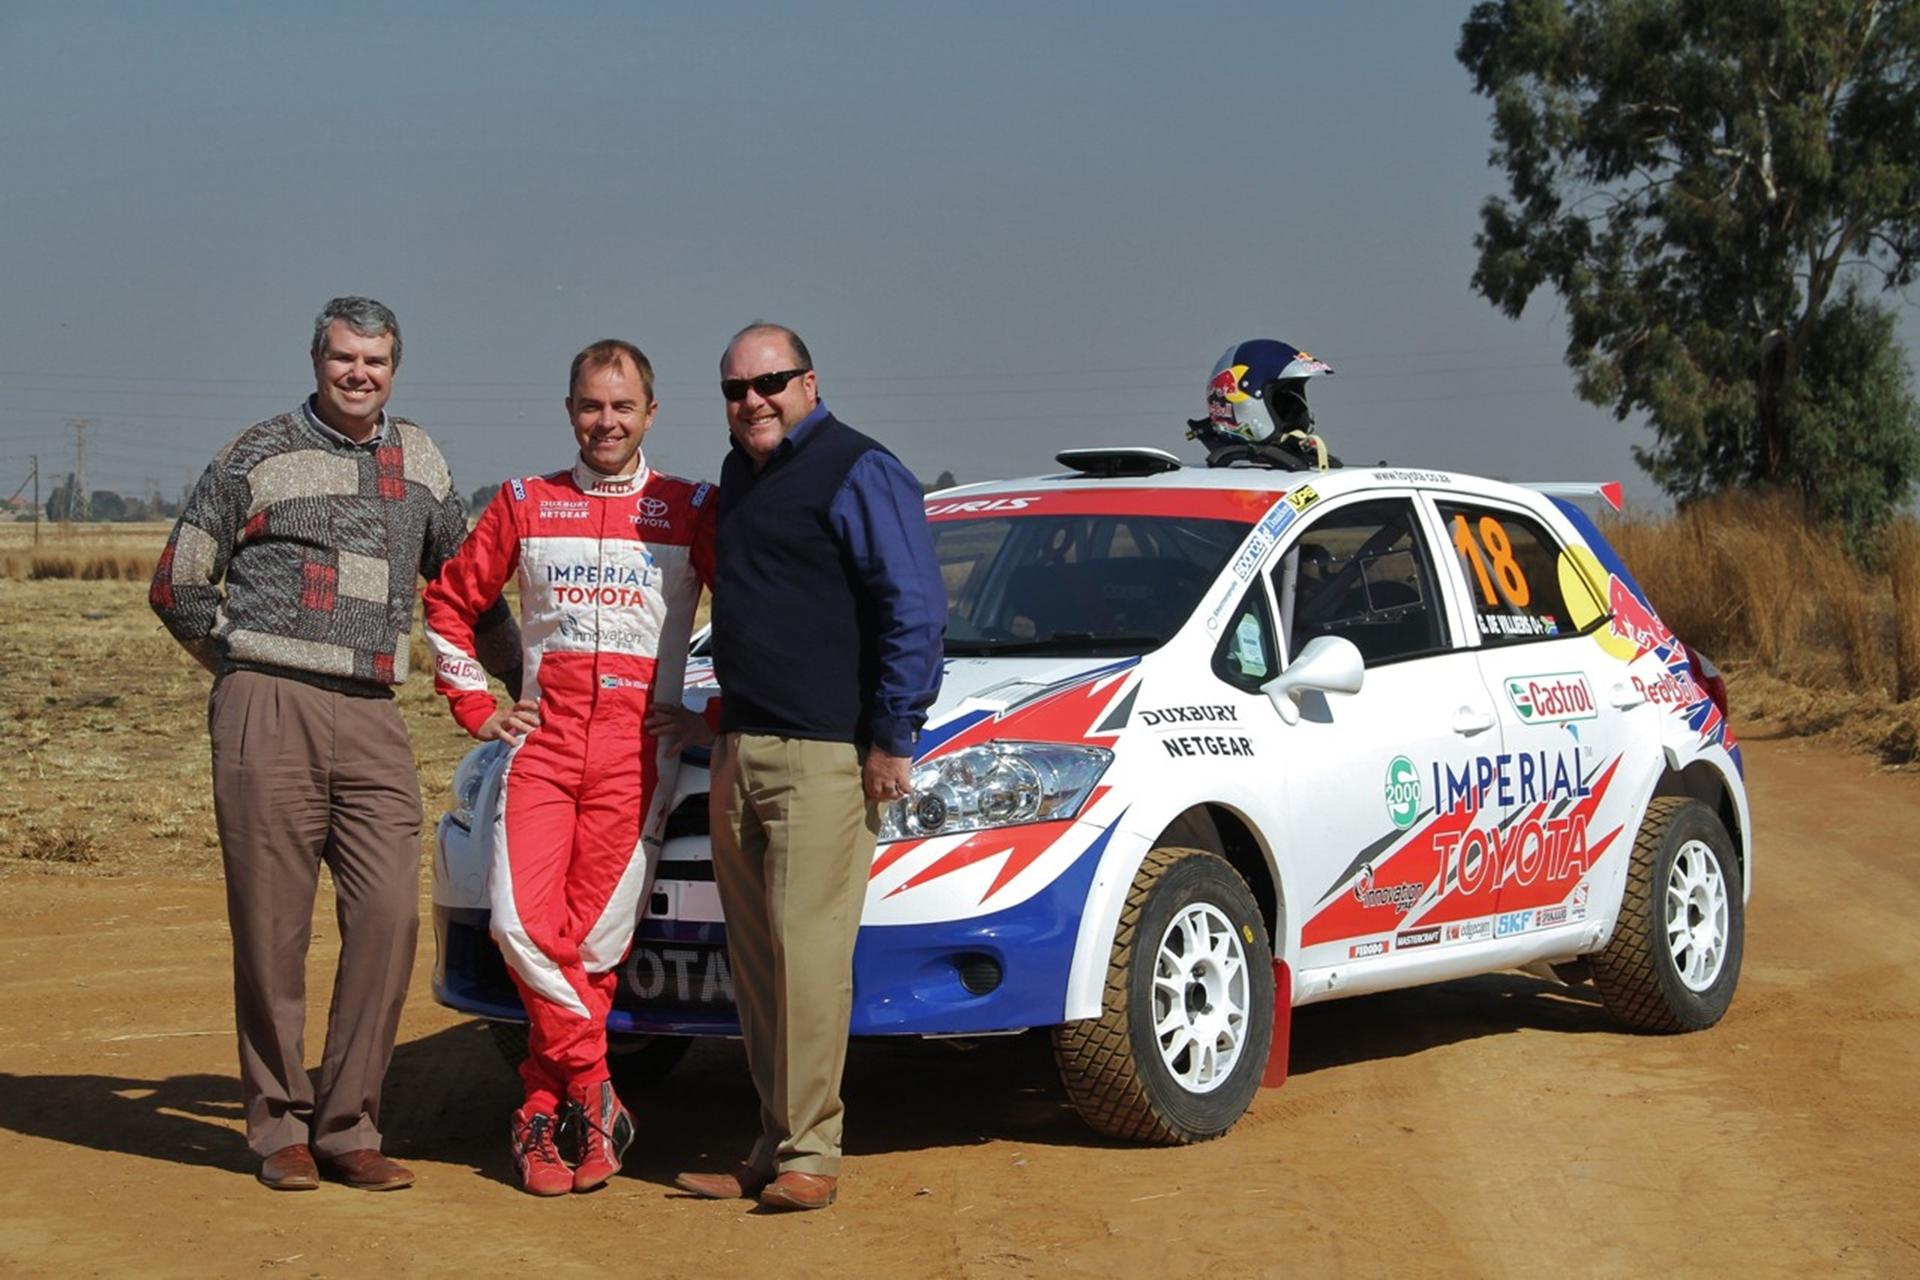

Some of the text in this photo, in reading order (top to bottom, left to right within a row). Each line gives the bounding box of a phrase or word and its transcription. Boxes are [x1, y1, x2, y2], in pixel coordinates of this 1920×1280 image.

[1372, 470, 1452, 483] www.toyota.co.za
[540, 511, 588, 519] NETGEAR
[629, 515, 671, 529] TOYOTA
[1453, 514, 1530, 607] 18
[547, 565, 652, 587] IMPERIAL
[553, 587, 644, 608] TOYOTA
[436, 654, 461, 677] Red
[1529, 679, 1594, 717] Castrol
[1138, 705, 1238, 726] DUXBURY
[1162, 736, 1255, 758] NETGEAR
[1386, 782, 1421, 803] 2000
[1432, 747, 1591, 816] IMPERIAL
[1432, 814, 1589, 896] TOYOTA
[1363, 883, 1423, 907] innovation
[1498, 911, 1533, 935] SKF
